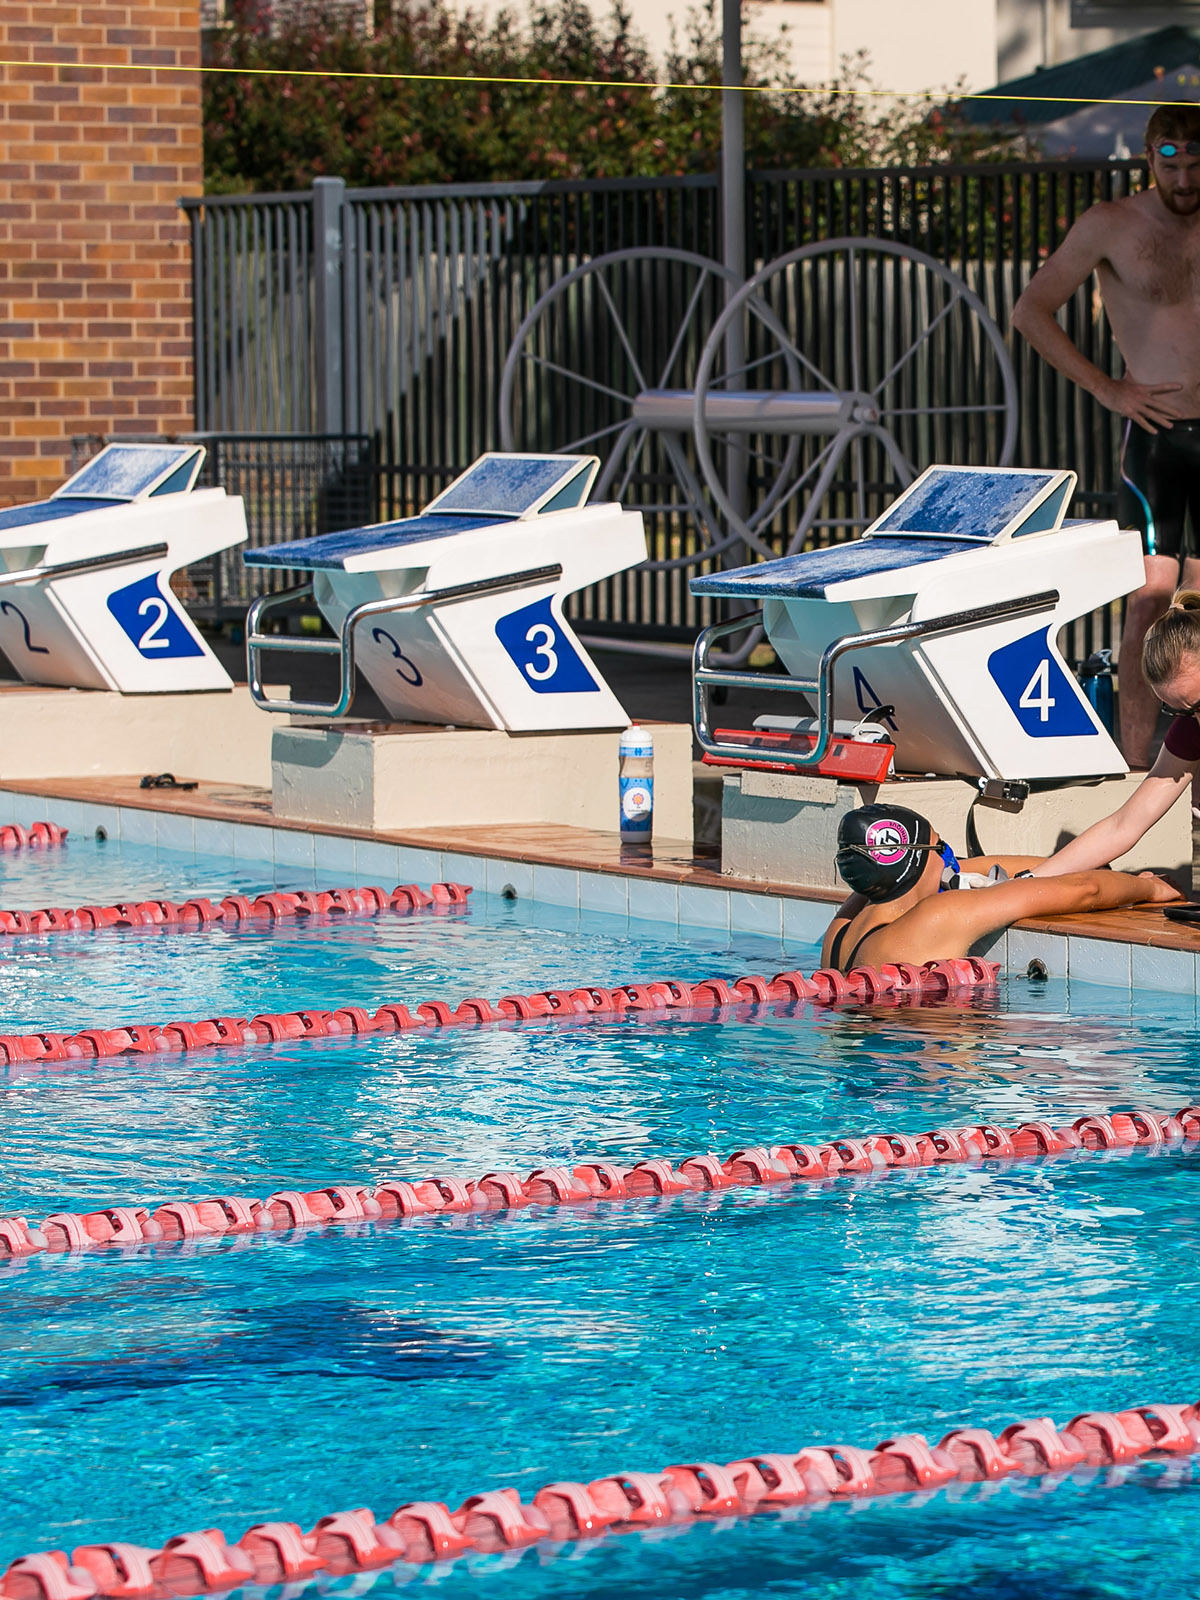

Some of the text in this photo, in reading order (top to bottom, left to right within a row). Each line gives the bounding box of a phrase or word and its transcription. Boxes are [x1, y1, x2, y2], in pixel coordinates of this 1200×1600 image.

[0, 600, 50, 654] 2
[138, 597, 169, 649] 2
[525, 623, 558, 680] 3
[372, 627, 423, 686] 3
[852, 666, 899, 731] 4
[1019, 659, 1055, 722] 4
